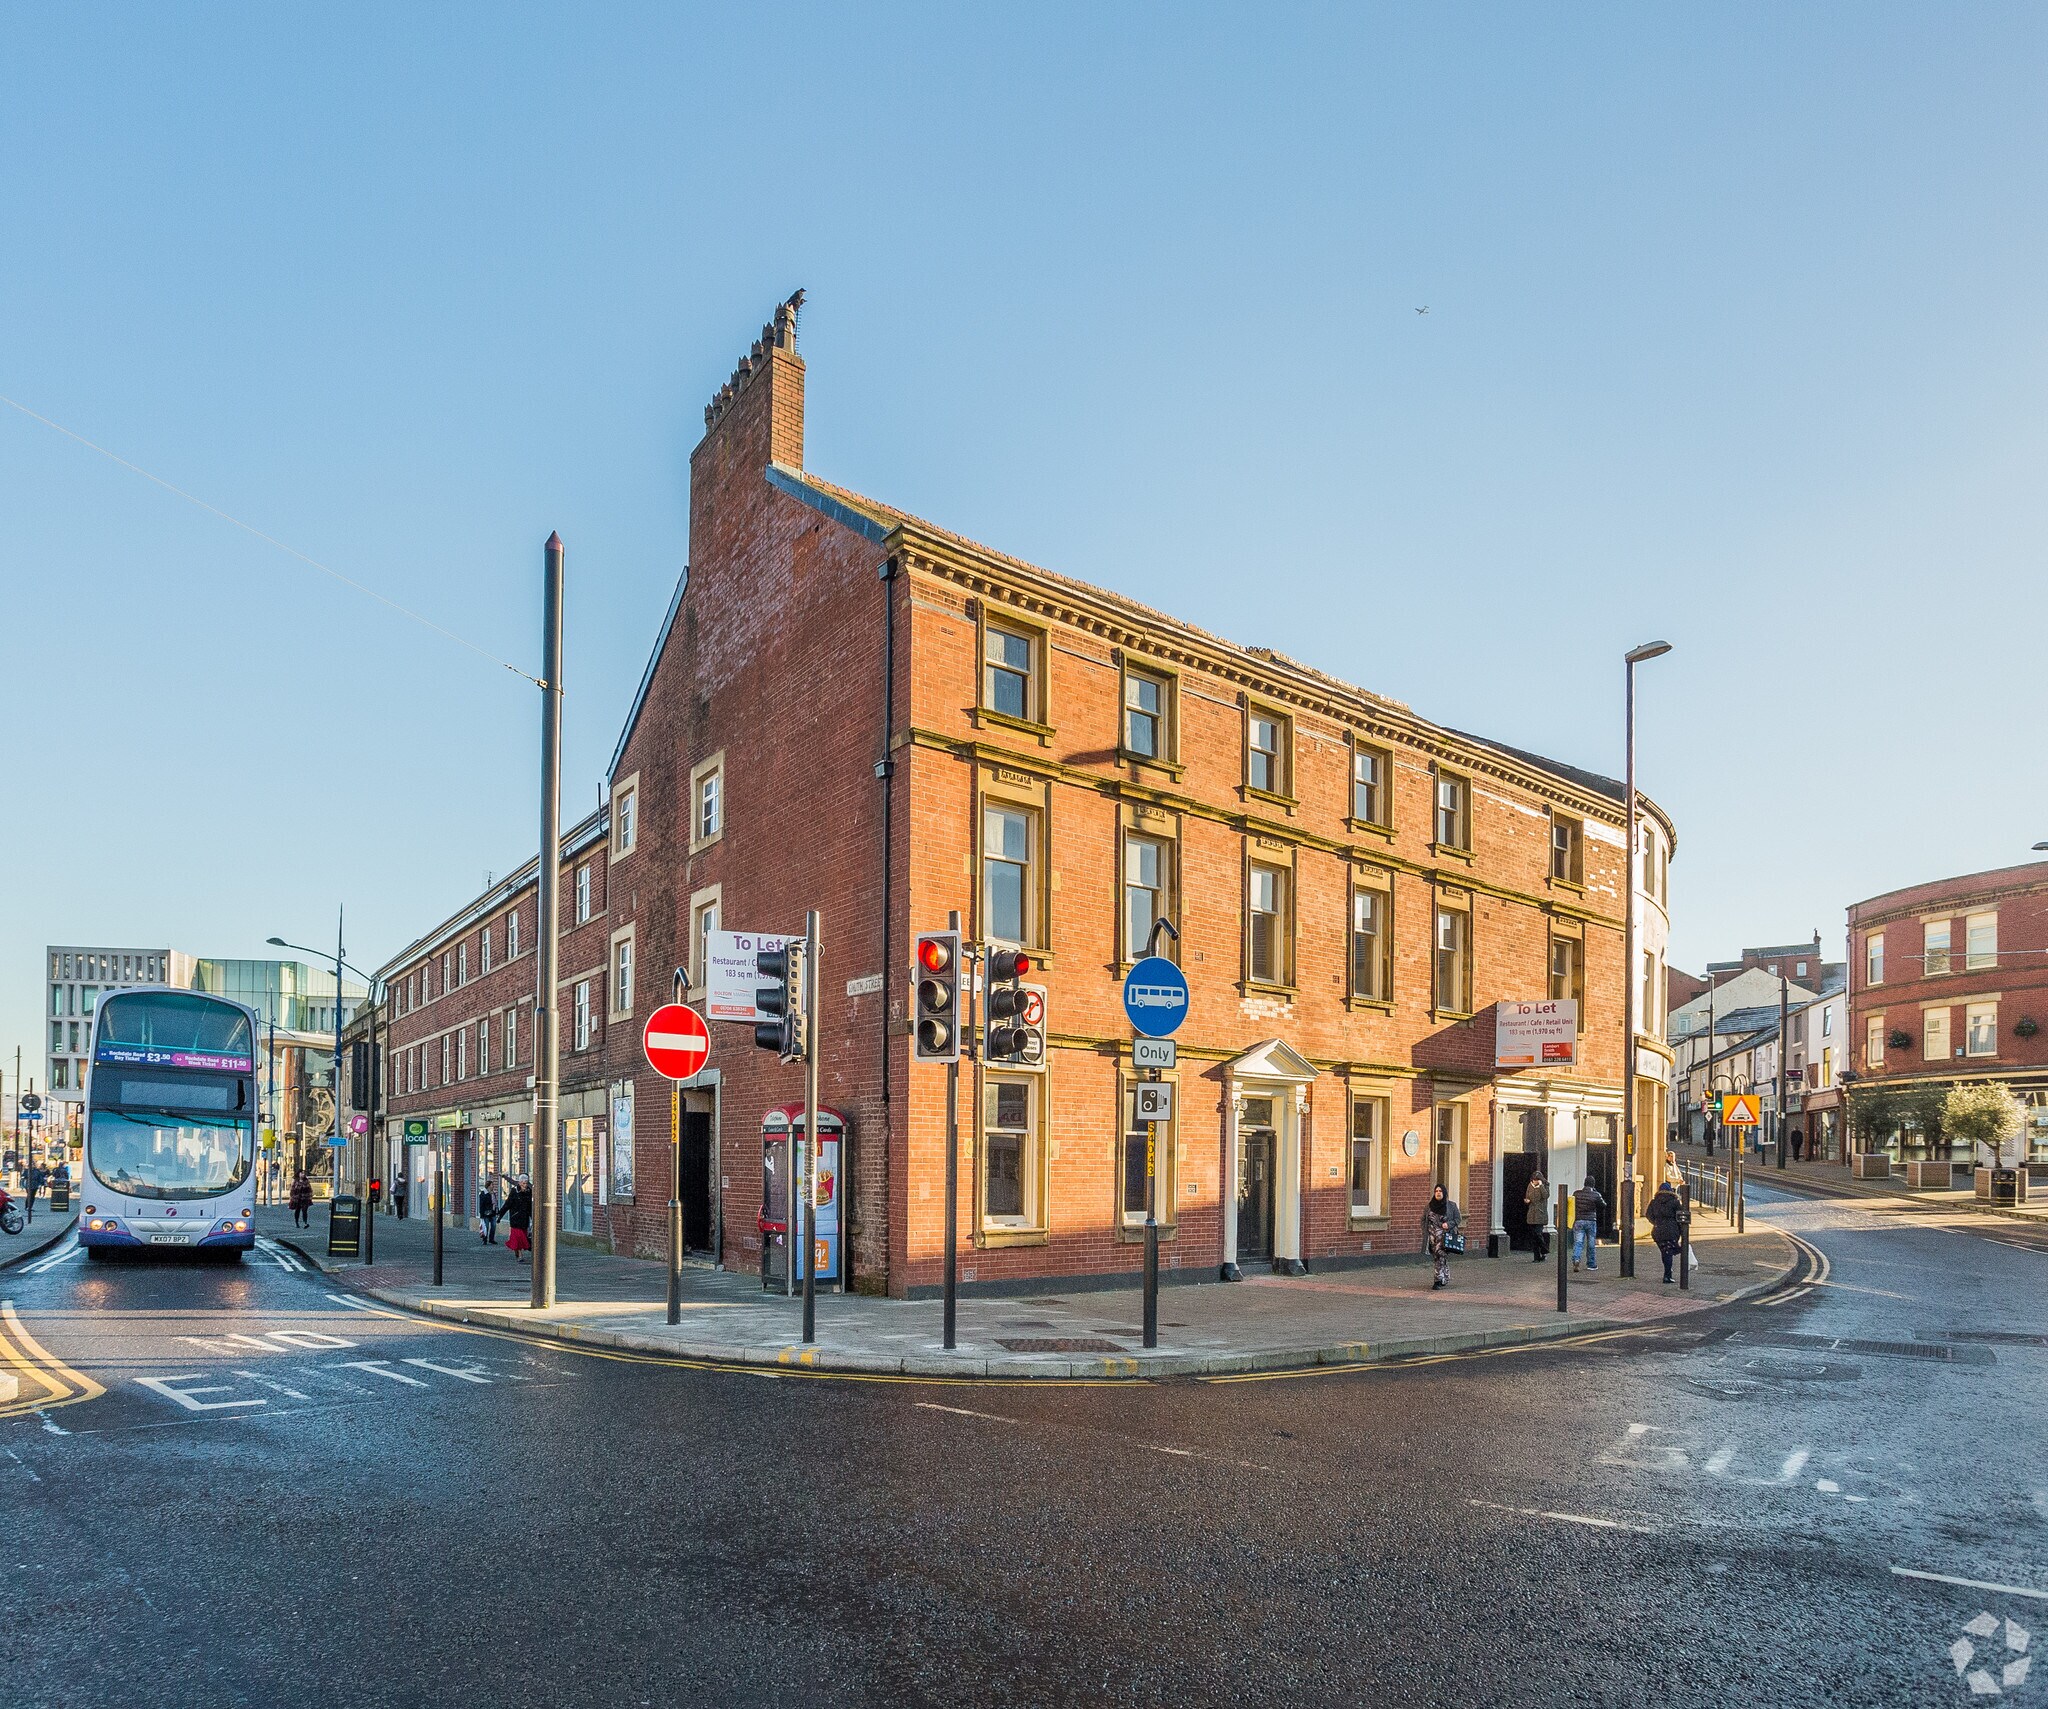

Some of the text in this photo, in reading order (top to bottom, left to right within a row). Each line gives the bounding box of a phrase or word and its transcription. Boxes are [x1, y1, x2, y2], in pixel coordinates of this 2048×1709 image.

[733, 935, 783, 952] To Let
[712, 956, 747, 967] Restaurant
[725, 969, 736, 978] 183
[737, 971, 745, 980] sq
[1516, 1002, 1557, 1014] To Let
[146, 1052, 171, 1063] £3.50
[1140, 1045, 1170, 1062] Only
[405, 1134, 428, 1142] local
